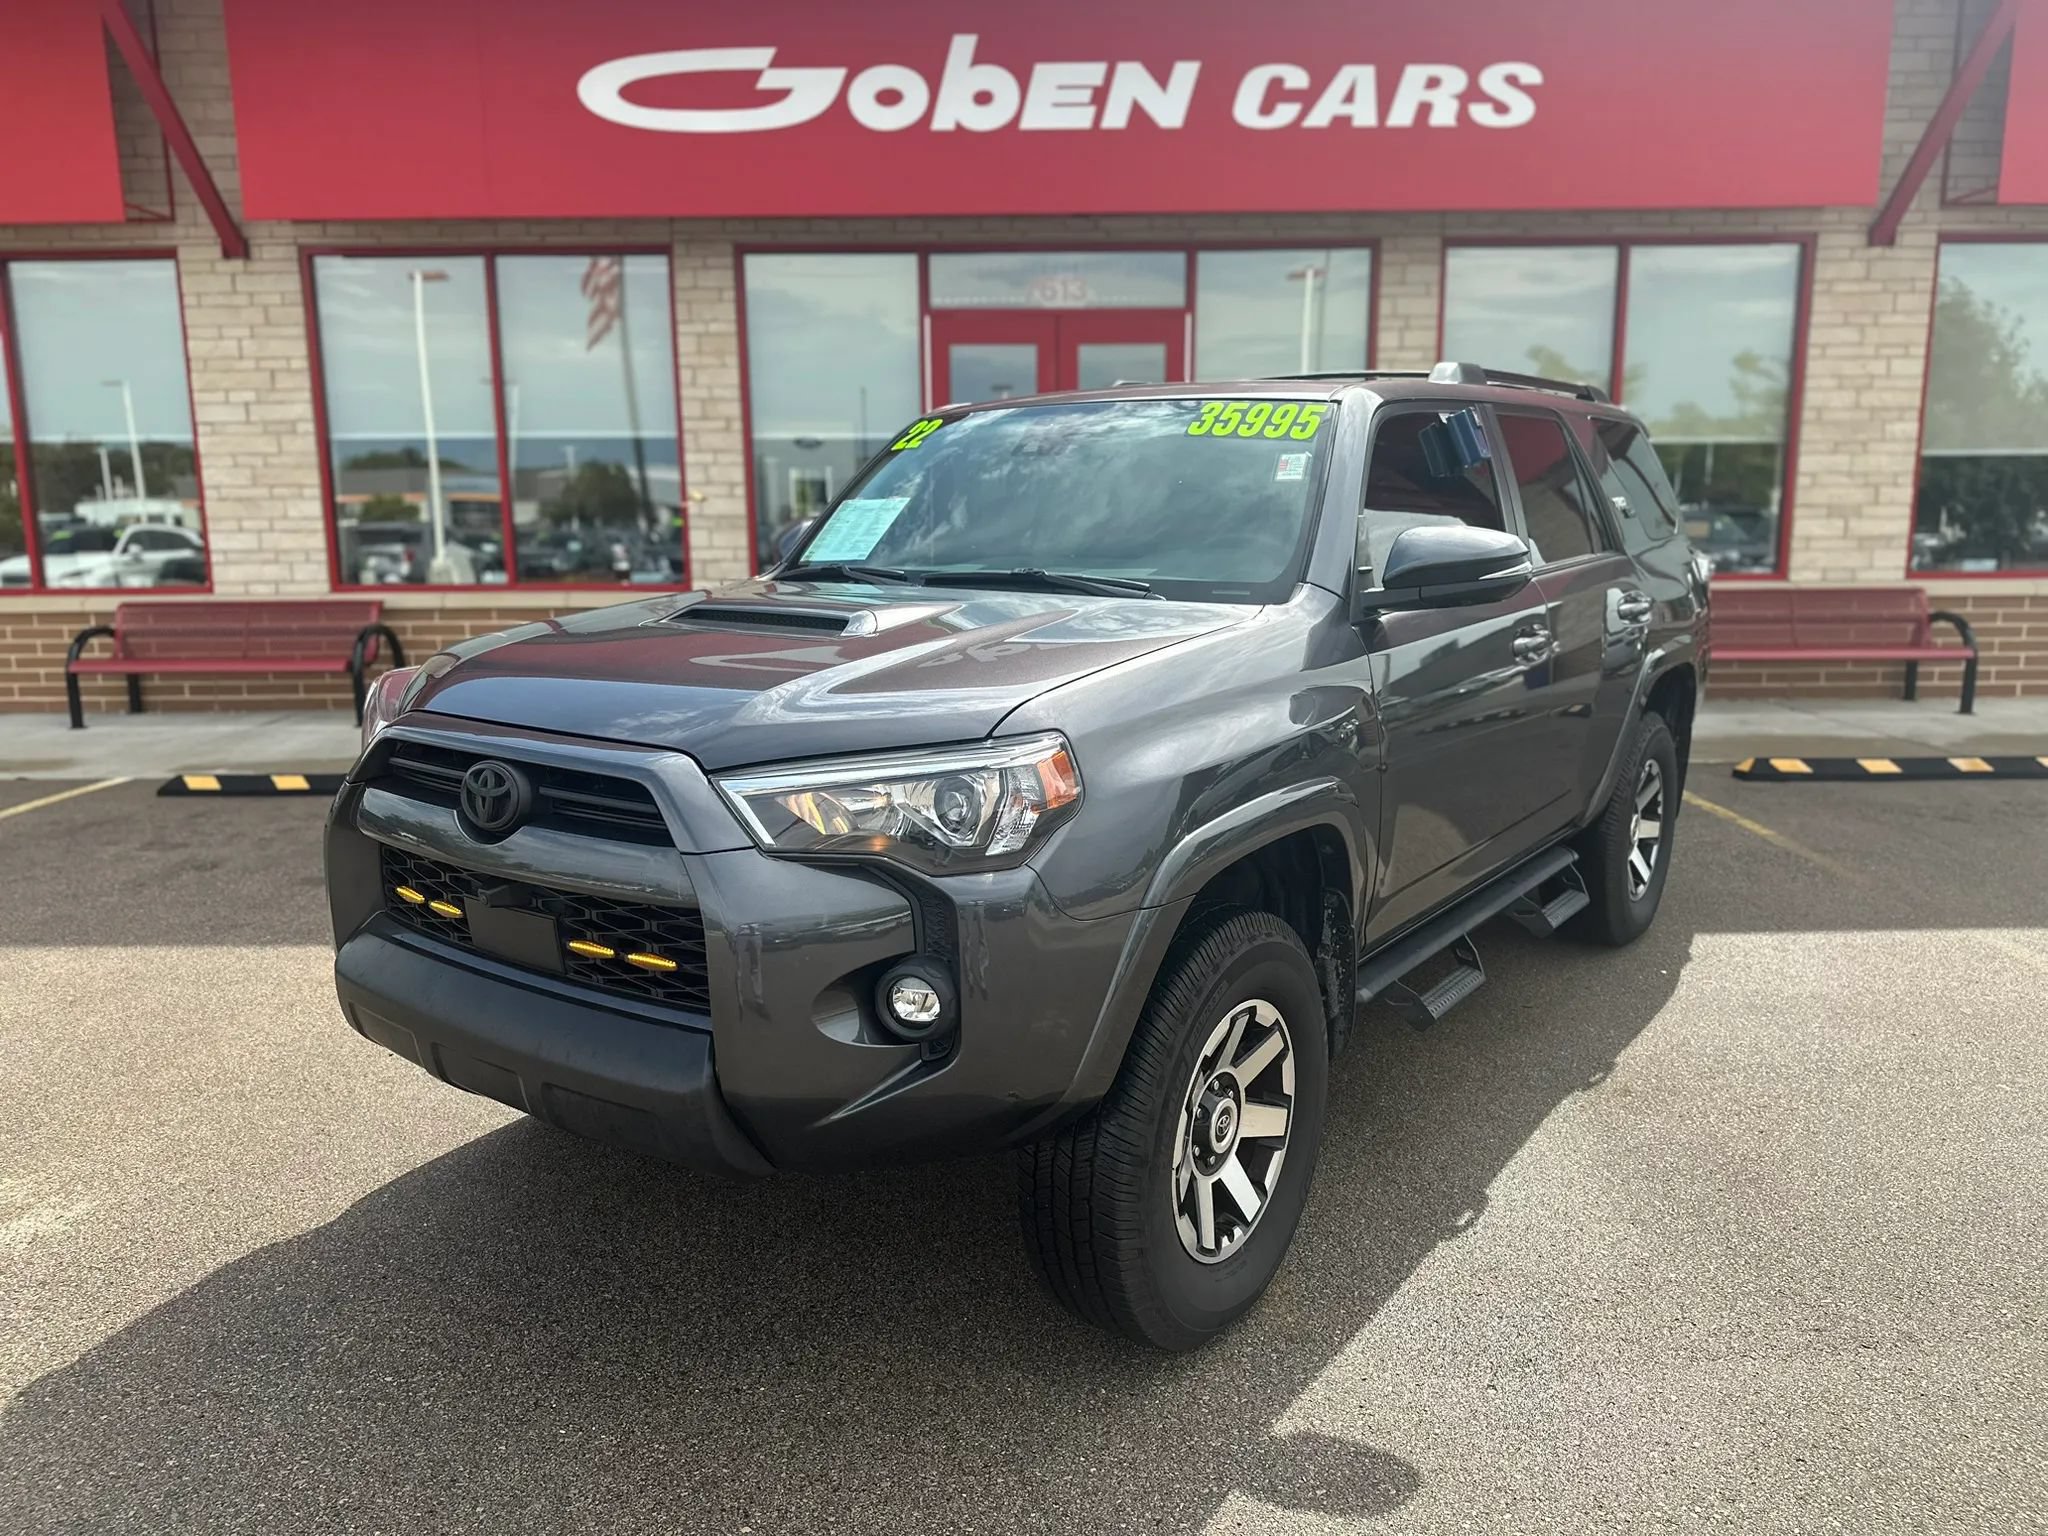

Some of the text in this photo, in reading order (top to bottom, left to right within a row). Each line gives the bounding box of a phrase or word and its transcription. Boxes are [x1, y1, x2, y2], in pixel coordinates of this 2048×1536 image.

[1233, 62, 1544, 130] CARS
[890, 419, 943, 452] 22
[1187, 402, 1328, 440] 35995
